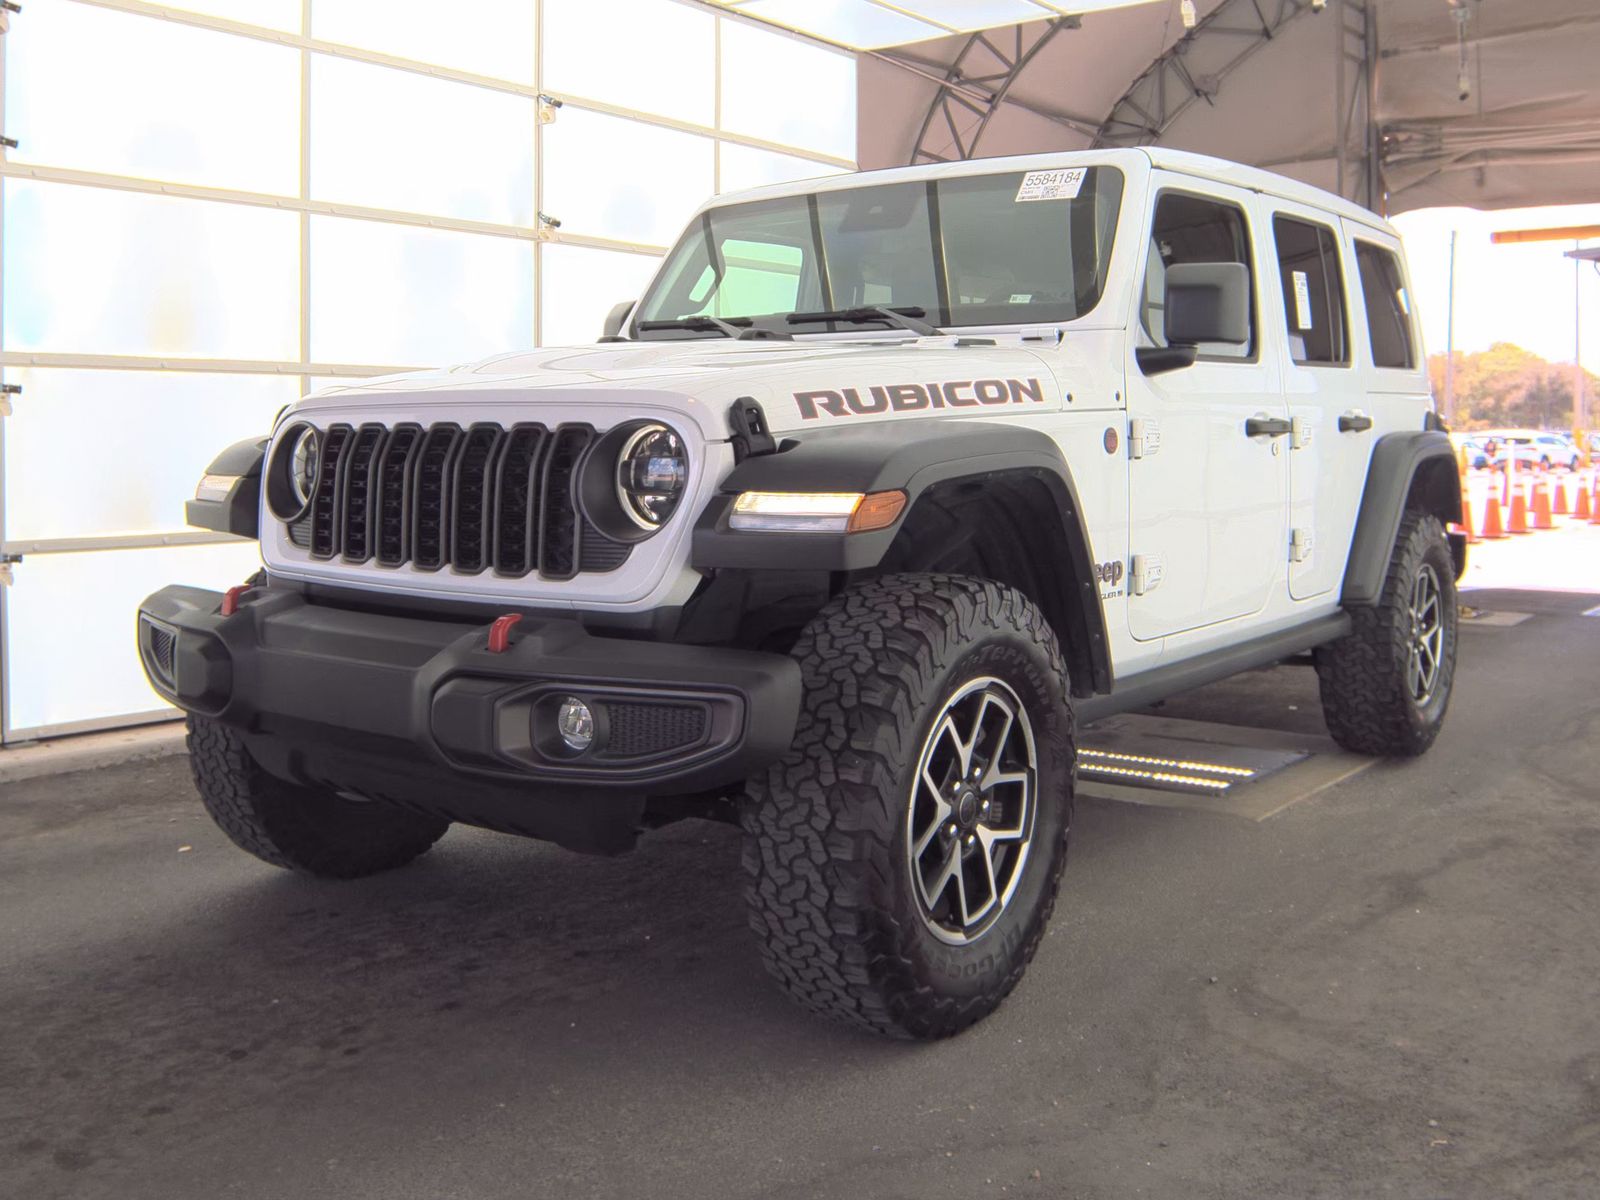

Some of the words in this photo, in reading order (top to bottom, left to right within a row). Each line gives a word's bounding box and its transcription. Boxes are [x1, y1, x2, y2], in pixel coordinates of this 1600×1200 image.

[1026, 170, 1082, 187] 5584184
[793, 378, 1045, 420] RUBICON
[1094, 560, 1123, 587] eep
